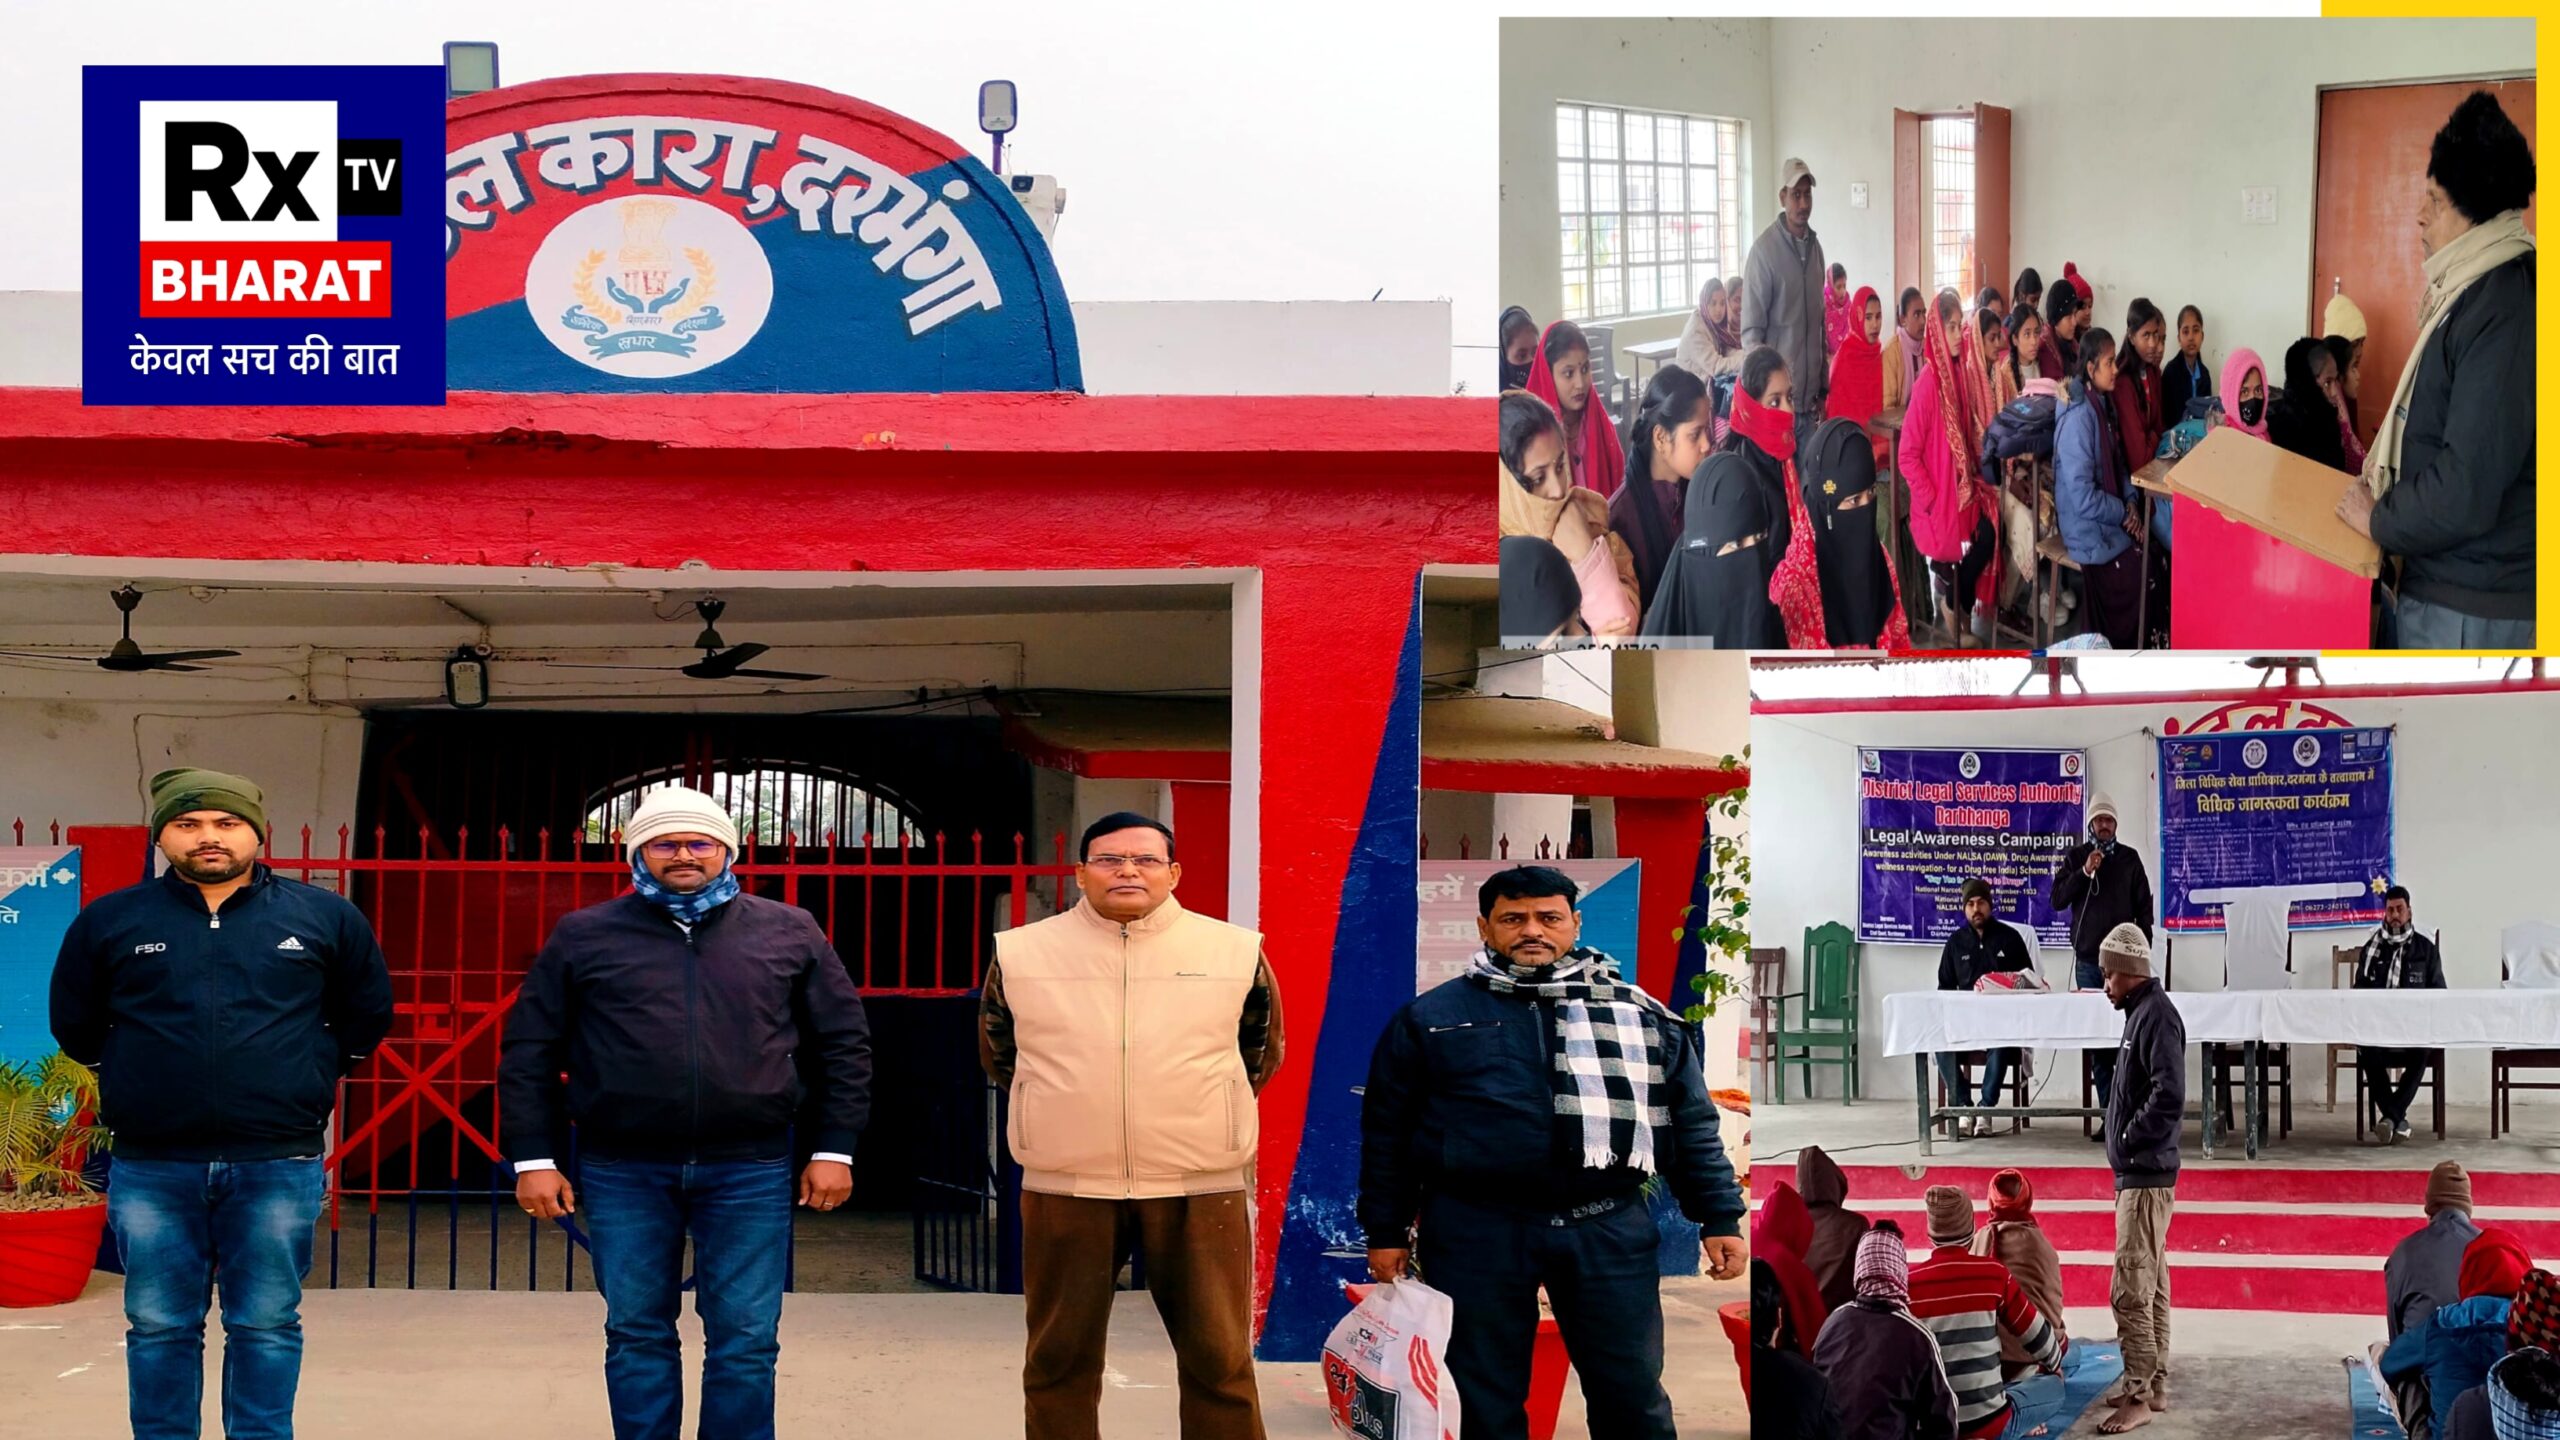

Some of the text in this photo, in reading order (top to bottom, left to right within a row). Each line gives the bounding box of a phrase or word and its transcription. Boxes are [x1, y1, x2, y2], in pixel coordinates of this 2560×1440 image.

[1862, 777, 2082, 805] District Legal Services Authority
[2197, 788, 2351, 813] विधिक जागरूकता कार्यक्रम
[1935, 805, 2011, 829] Darbhanga
[1869, 828, 2074, 850] Legal Awareness Campaign
[1863, 849, 1899, 858] Awareness
[1901, 850, 1932, 859] activities
[1934, 851, 1955, 860] Under
[1957, 852, 1982, 861] NALSA
[2011, 853, 2029, 863] Drug
[1947, 864, 1956, 872] for
